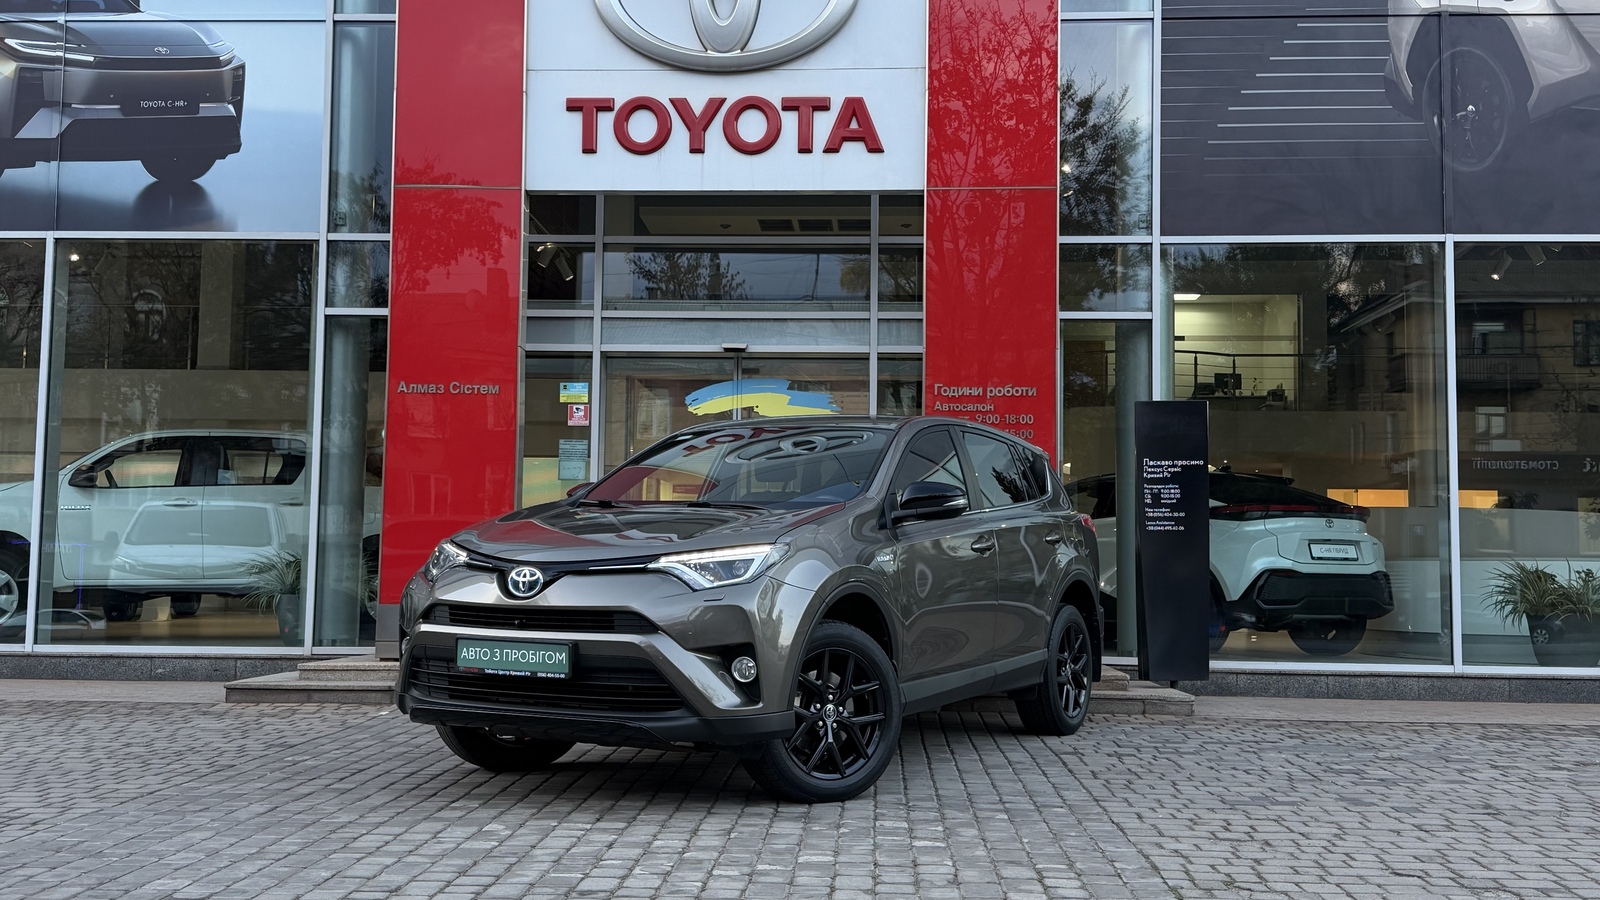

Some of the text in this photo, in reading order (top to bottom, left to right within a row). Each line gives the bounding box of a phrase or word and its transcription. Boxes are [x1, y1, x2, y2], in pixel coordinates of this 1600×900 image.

[140, 100, 188, 108] TOYOTA C-HR+
[565, 95, 885, 155] TOYOTA
[397, 381, 499, 394] Алмаз Сістем
[934, 383, 1037, 399] Години роботи
[934, 401, 994, 411] Автосалон
[975, 414, 1034, 424] 9:00-18:00
[460, 647, 490, 660] АВТО
[503, 649, 566, 664] ПРОБІГОМ
